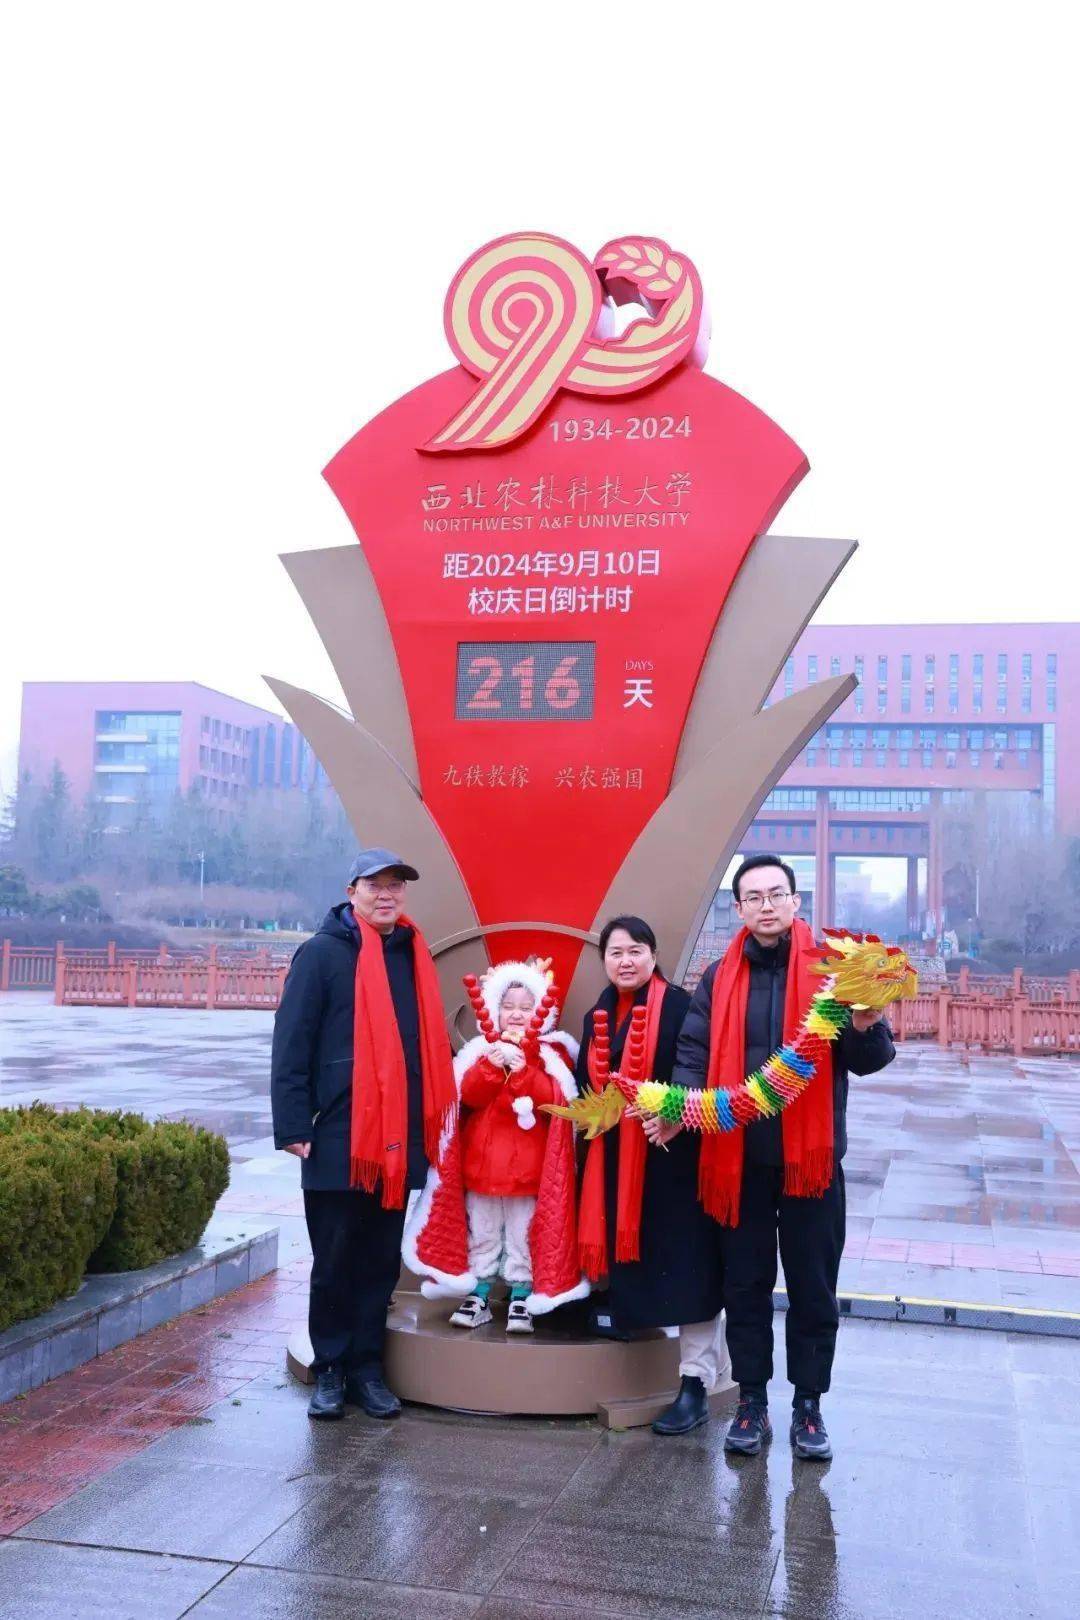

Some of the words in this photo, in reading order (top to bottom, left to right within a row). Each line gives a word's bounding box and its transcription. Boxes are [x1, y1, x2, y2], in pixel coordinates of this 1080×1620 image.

[550, 416, 693, 442] 1934-2024
[421, 472, 693, 511] 西北农林科技大学
[423, 516, 533, 533] NORTHWEST
[539, 515, 573, 529] A&F
[578, 512, 690, 529] UNIVERSITY
[442, 550, 660, 579] 距2024年9月10日
[468, 585, 633, 614] 校庆日倒计时
[625, 660, 654, 671] DAYS
[467, 655, 582, 710] 216
[623, 678, 653, 708] 天
[442, 764, 530, 788] 九秩教稼
[554, 765, 643, 790] 兴农强国
